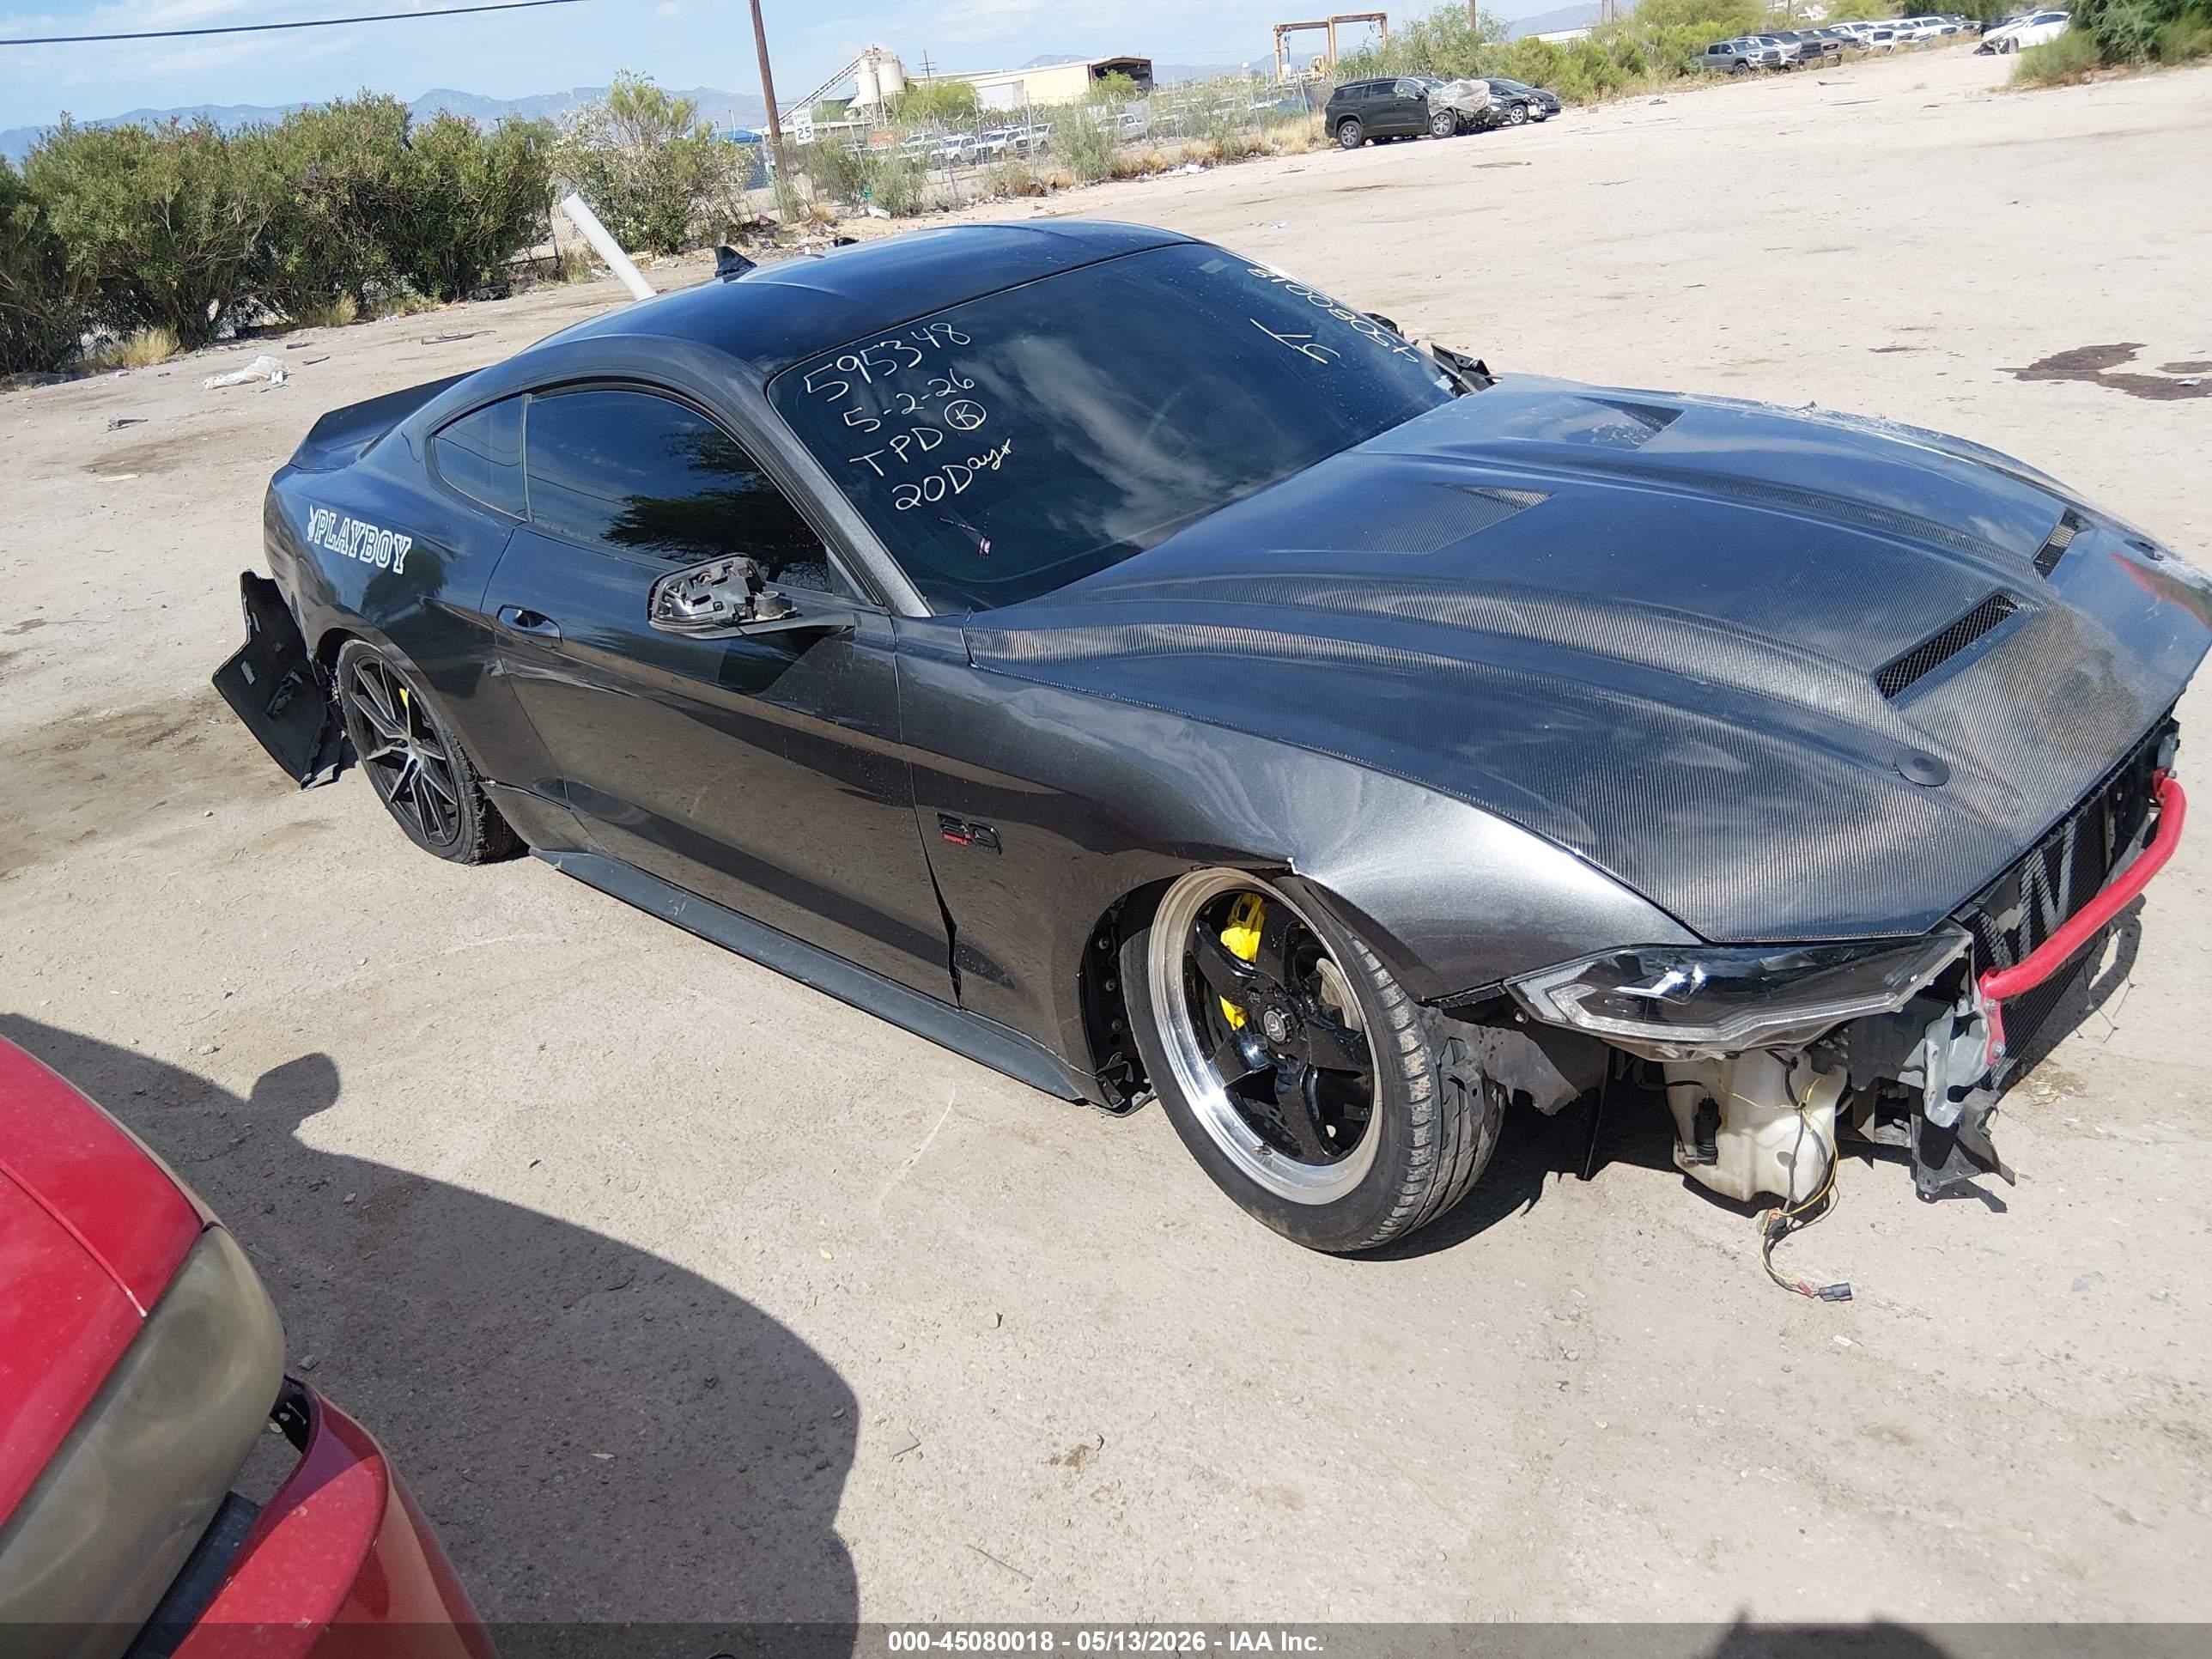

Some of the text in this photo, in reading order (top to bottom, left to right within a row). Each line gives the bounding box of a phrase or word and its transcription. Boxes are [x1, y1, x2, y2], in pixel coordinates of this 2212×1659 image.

[796, 126, 812, 140] 25
[1247, 267, 1419, 363] 45080018
[804, 322, 971, 403] 595348
[842, 367, 975, 433] 5-2-26
[848, 427, 943, 477] TPD
[313, 508, 413, 575] PLAYBOY
